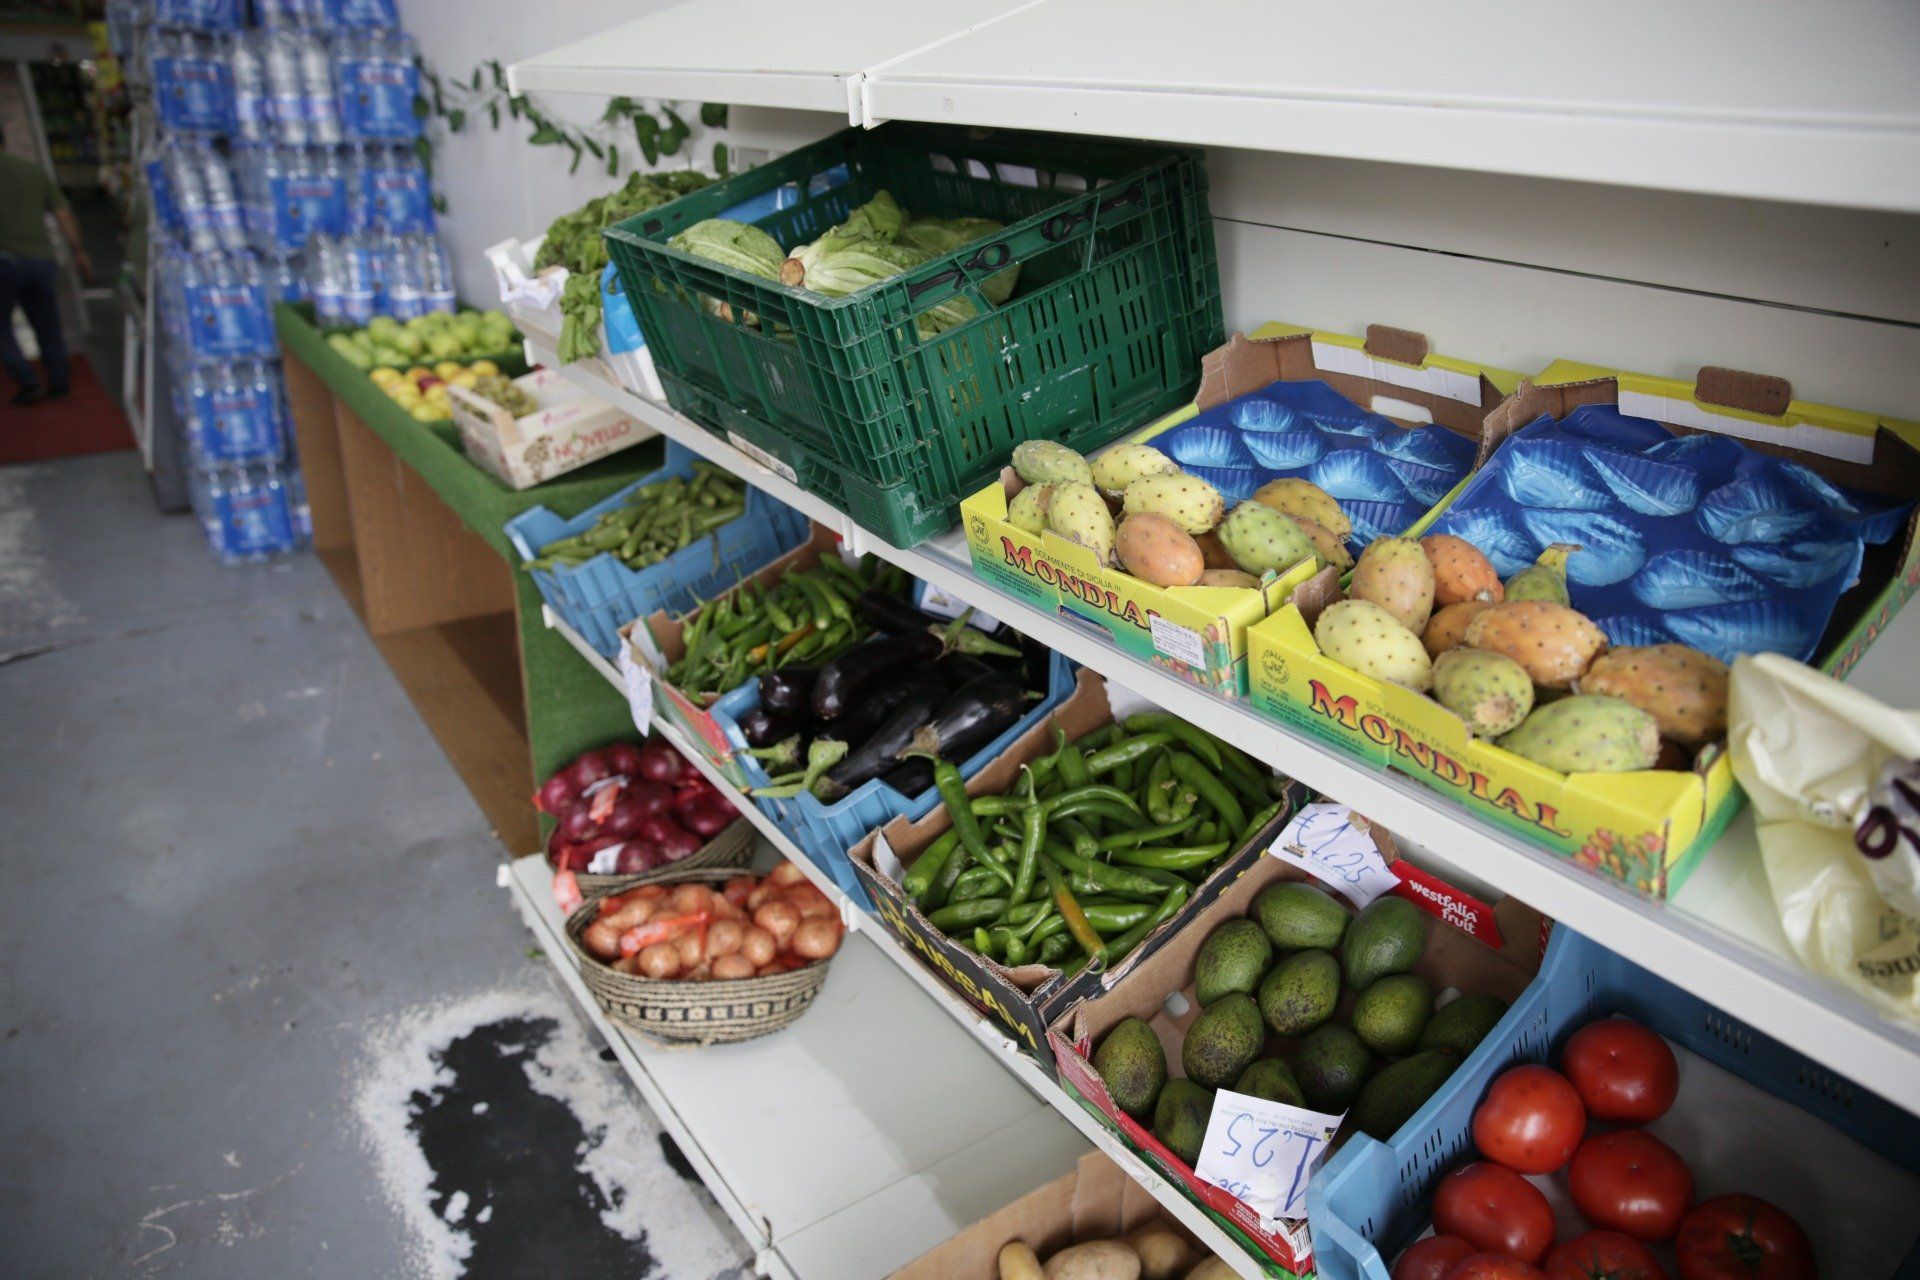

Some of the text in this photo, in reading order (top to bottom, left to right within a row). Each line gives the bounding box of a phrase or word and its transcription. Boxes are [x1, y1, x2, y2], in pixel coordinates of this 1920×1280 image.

[1307, 678, 1571, 838] MONDIAL
[1409, 879, 1478, 924] westfalia
[1442, 907, 1476, 935] fruit
